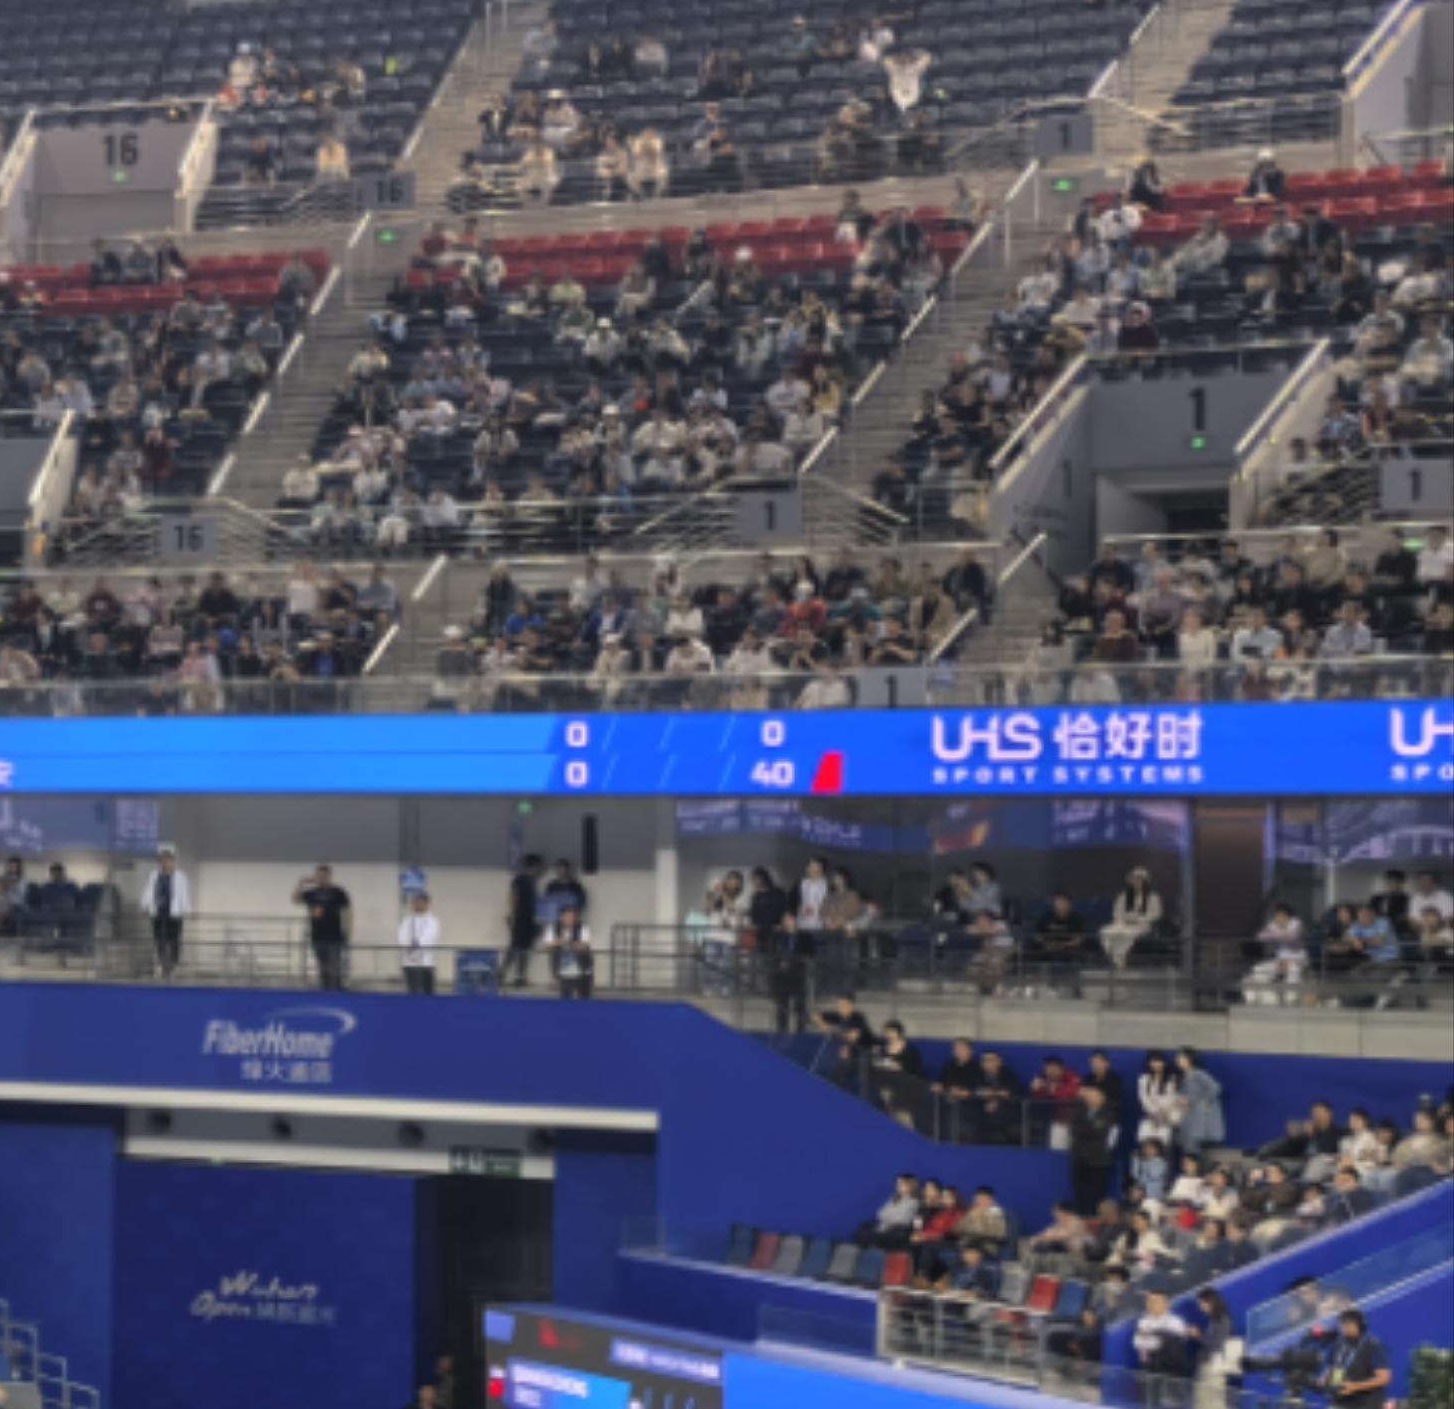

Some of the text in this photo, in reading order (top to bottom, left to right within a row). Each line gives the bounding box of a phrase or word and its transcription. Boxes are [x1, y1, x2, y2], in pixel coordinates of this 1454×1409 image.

[104, 133, 139, 168] 16
[375, 180, 403, 204] 16
[174, 525, 204, 551] 16
[566, 720, 783, 749] 0 0
[1053, 710, 1204, 759] 恰好时
[566, 761, 795, 788] 0 40
[203, 1019, 335, 1058] FiberHome
